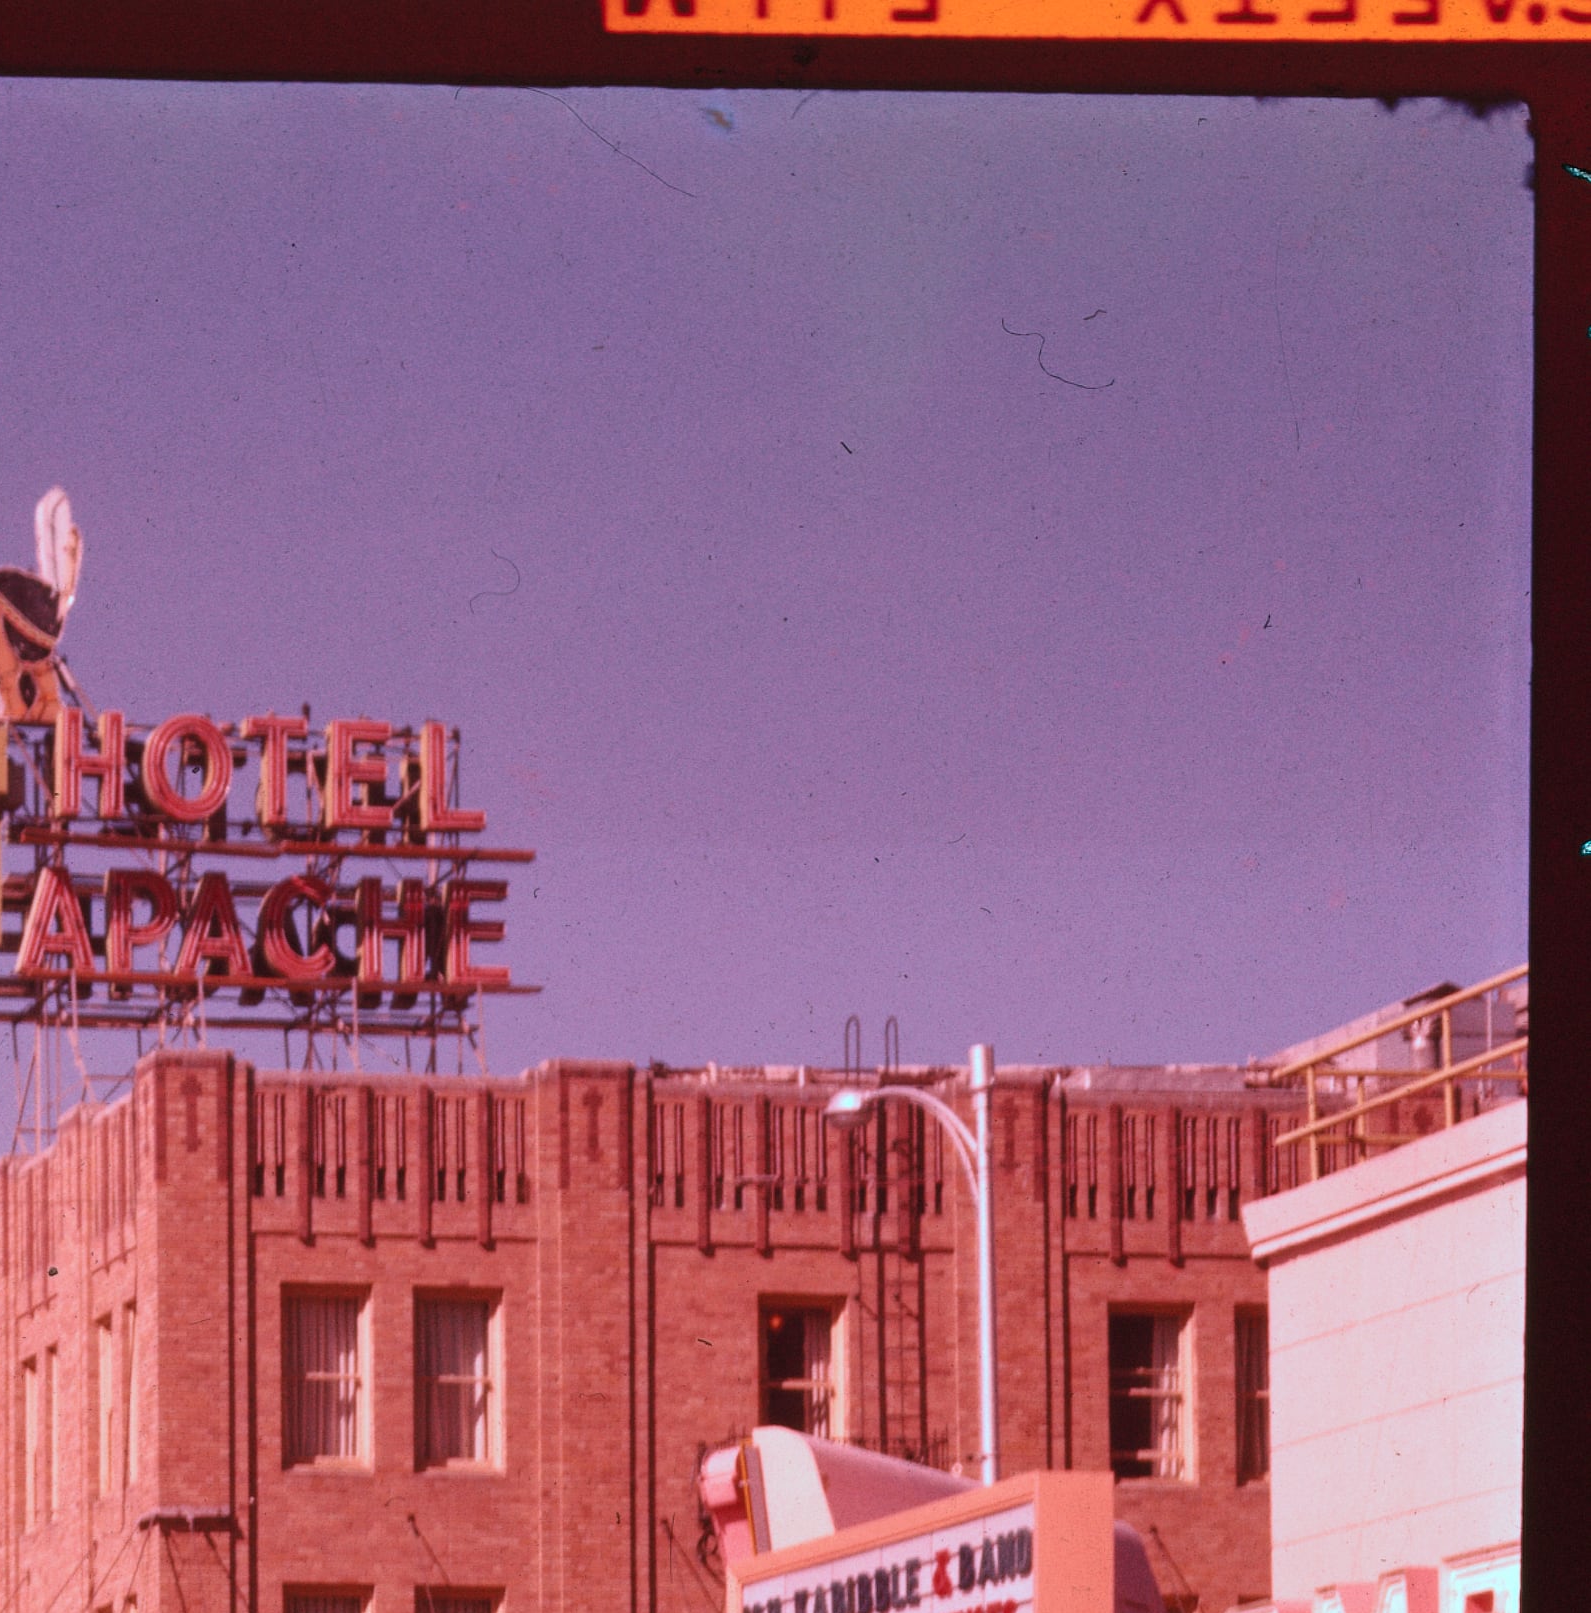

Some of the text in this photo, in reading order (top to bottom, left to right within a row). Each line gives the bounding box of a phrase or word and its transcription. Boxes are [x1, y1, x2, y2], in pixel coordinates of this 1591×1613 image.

[54, 708, 486, 831] HOTEL
[17, 867, 511, 985] APACHE
[932, 1548, 954, 1599] &
[957, 1526, 1034, 1593] BAND
